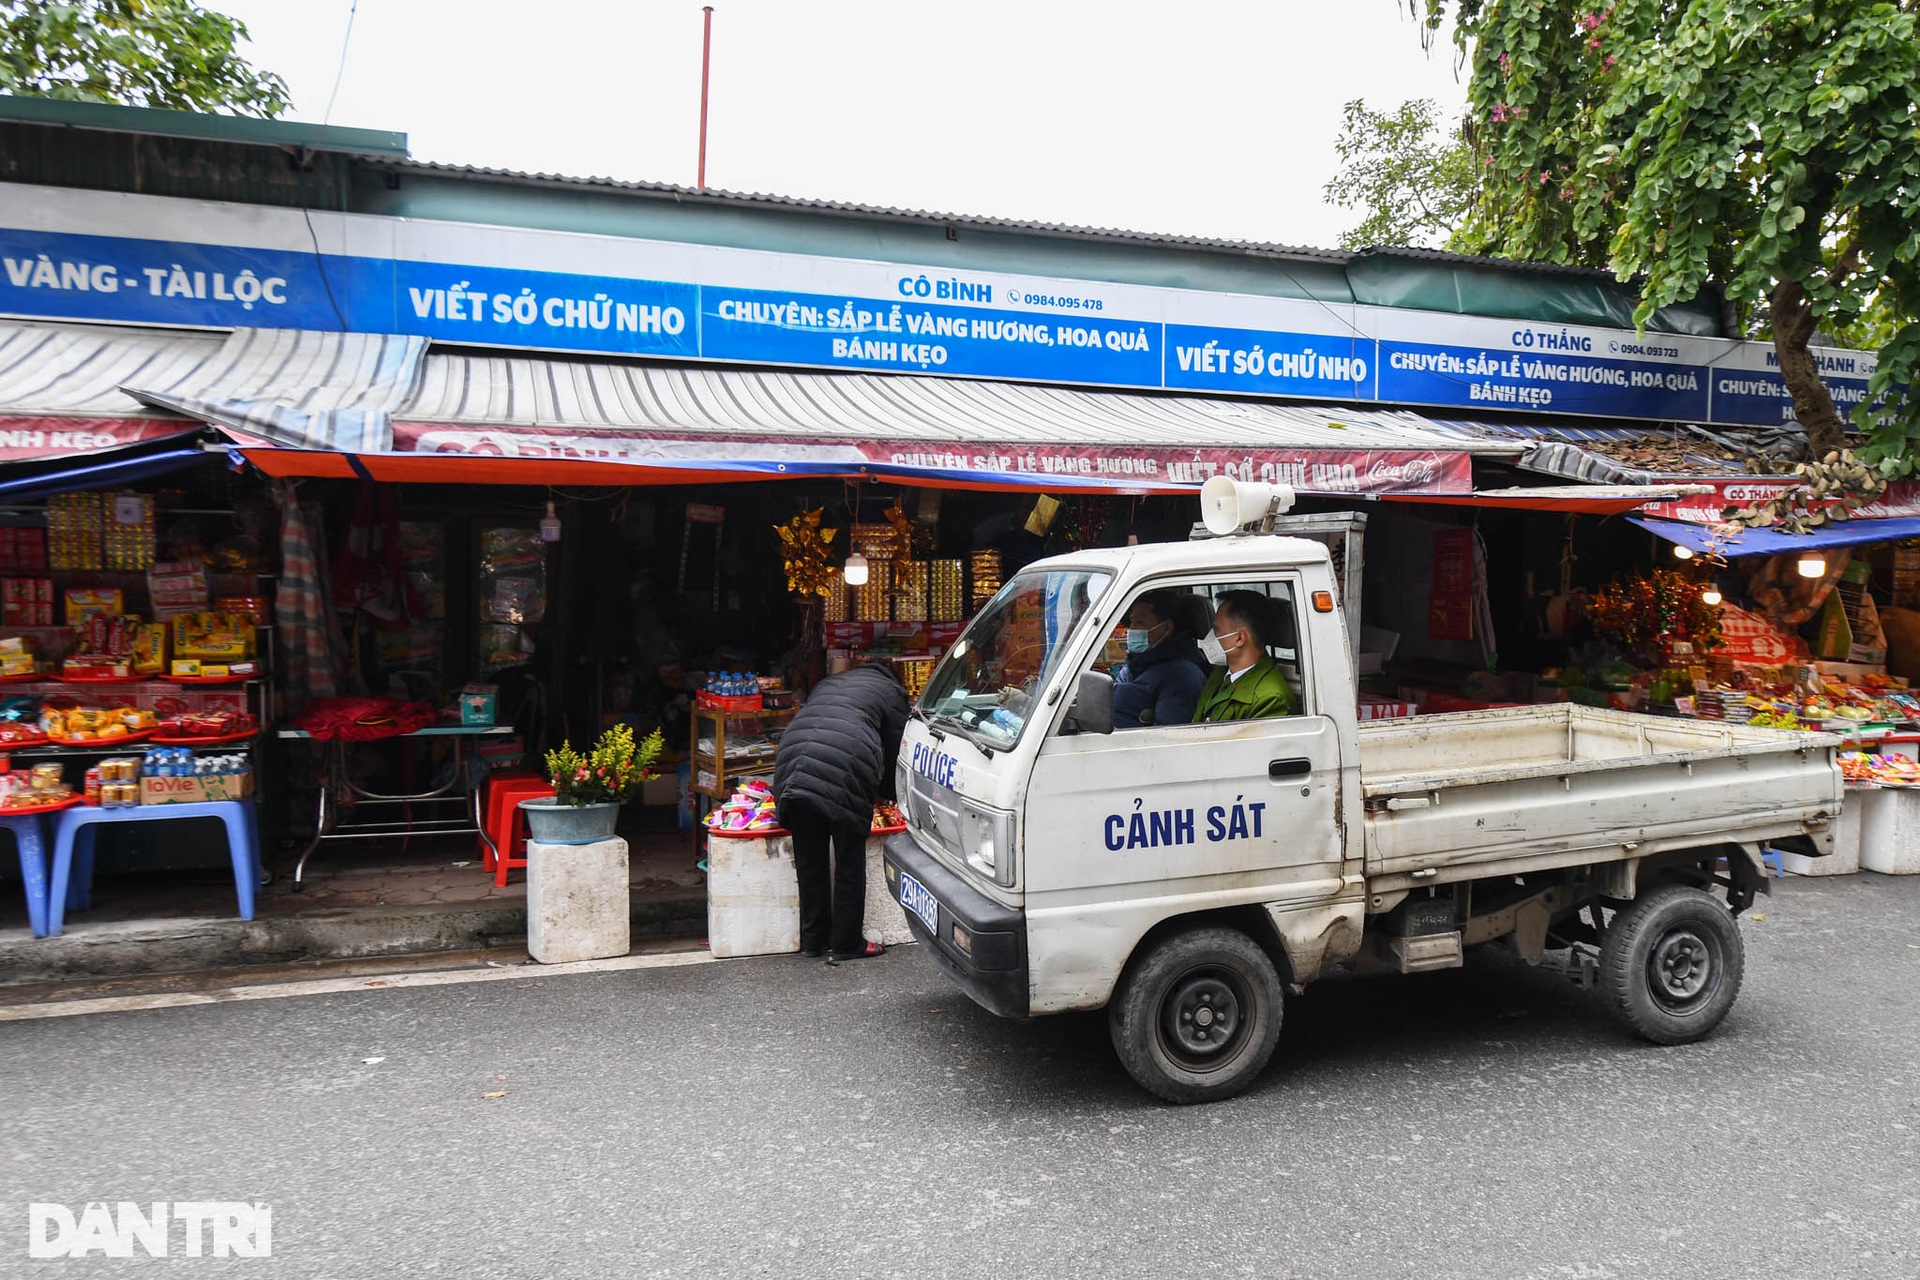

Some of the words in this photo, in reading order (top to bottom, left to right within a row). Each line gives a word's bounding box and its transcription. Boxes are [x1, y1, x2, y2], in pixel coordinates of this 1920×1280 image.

[4, 255, 117, 293] VÀNG
[143, 264, 206, 299] TÀI
[213, 269, 287, 310] LỘC
[899, 275, 931, 297] CÔ
[937, 278, 992, 303] BÌNH
[409, 281, 487, 322] VIẾT
[493, 288, 538, 325] SỚ
[543, 293, 613, 330] CHỮ
[616, 303, 685, 335] NHO
[719, 300, 824, 326] CHUYÊN:
[827, 301, 873, 329] SẮP
[876, 304, 902, 333] LỄ
[906, 312, 967, 337] VÀNG
[971, 319, 1054, 347] HƯƠNG,
[1058, 327, 1102, 348] HOA
[1105, 328, 1150, 352] QUẢ
[1512, 329, 1534, 347] CÔ
[1537, 328, 1592, 352] THẮNG
[832, 336, 897, 361] BÁNH
[901, 344, 948, 369] KẸO
[1176, 340, 1230, 373] VIẾT
[1233, 345, 1265, 375] SỚ
[1268, 348, 1317, 378] CHỮ
[1319, 356, 1367, 382] NHO
[1390, 352, 1465, 374] CHUYÊN:
[1466, 352, 1500, 376] SẮP
[1501, 354, 1521, 378] LỄ
[1523, 361, 1567, 381] VÀNG
[1570, 365, 1629, 388] HƯƠNG,
[1631, 371, 1664, 388] HOA
[1666, 371, 1698, 391] QUẢ
[1470, 381, 1517, 402] BÁNH
[1519, 386, 1553, 408] KẸO
[1719, 378, 1781, 398] CHUYÊN:
[1829, 385, 1866, 403] VÀNG
[50, 431, 117, 450] KẸO
[1017, 451, 1037, 472] LỄ
[1042, 454, 1091, 473] VÀNG
[1097, 456, 1158, 474] HƯƠNG
[1730, 488, 1746, 499] CÔ
[913, 742, 959, 790] POLICE
[1104, 798, 1195, 851] CẢNH
[1206, 795, 1266, 842] SÁT
